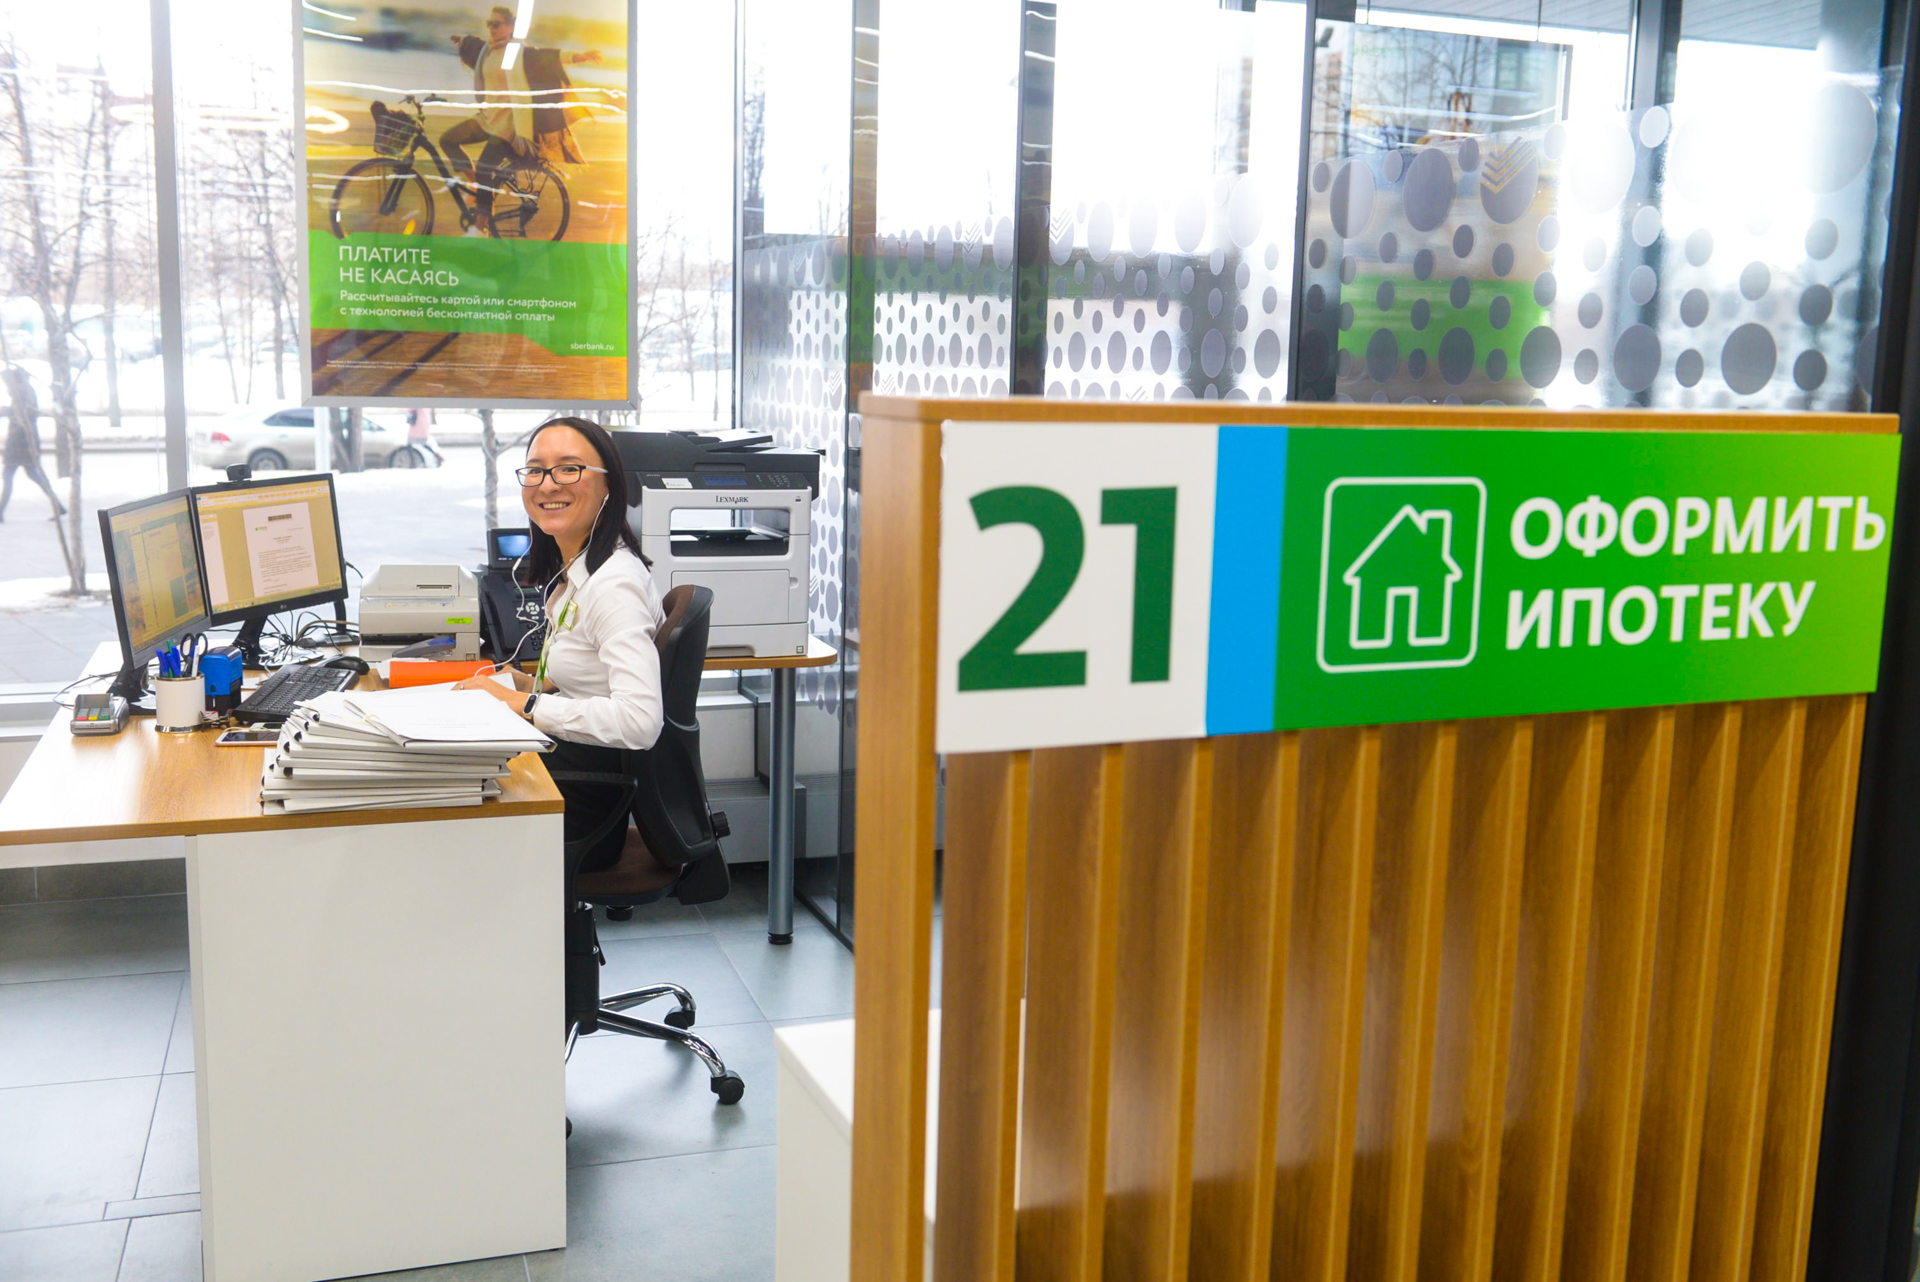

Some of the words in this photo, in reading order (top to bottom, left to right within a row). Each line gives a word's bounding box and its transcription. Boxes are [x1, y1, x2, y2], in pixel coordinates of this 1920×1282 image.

[339, 245, 431, 265] ПЛАТИТЕ
[339, 266, 366, 283] НЕ
[371, 268, 460, 287] КАСАЯСЬ
[340, 289, 439, 305] Рассчитывайтесь
[441, 295, 481, 307] картой
[483, 297, 505, 306] или
[507, 298, 577, 310] смартфоном
[339, 307, 347, 316] с
[349, 306, 424, 318] технологией
[426, 307, 512, 320] бесконтактной
[514, 312, 556, 322] оплаты
[570, 342, 615, 351] sberbank.ru
[715, 495, 749, 504] LEXMARK
[1509, 494, 1887, 560] ОФОРМИТЬ
[957, 485, 1178, 693] 21
[1505, 580, 1817, 651] ИПОТЕКУ
